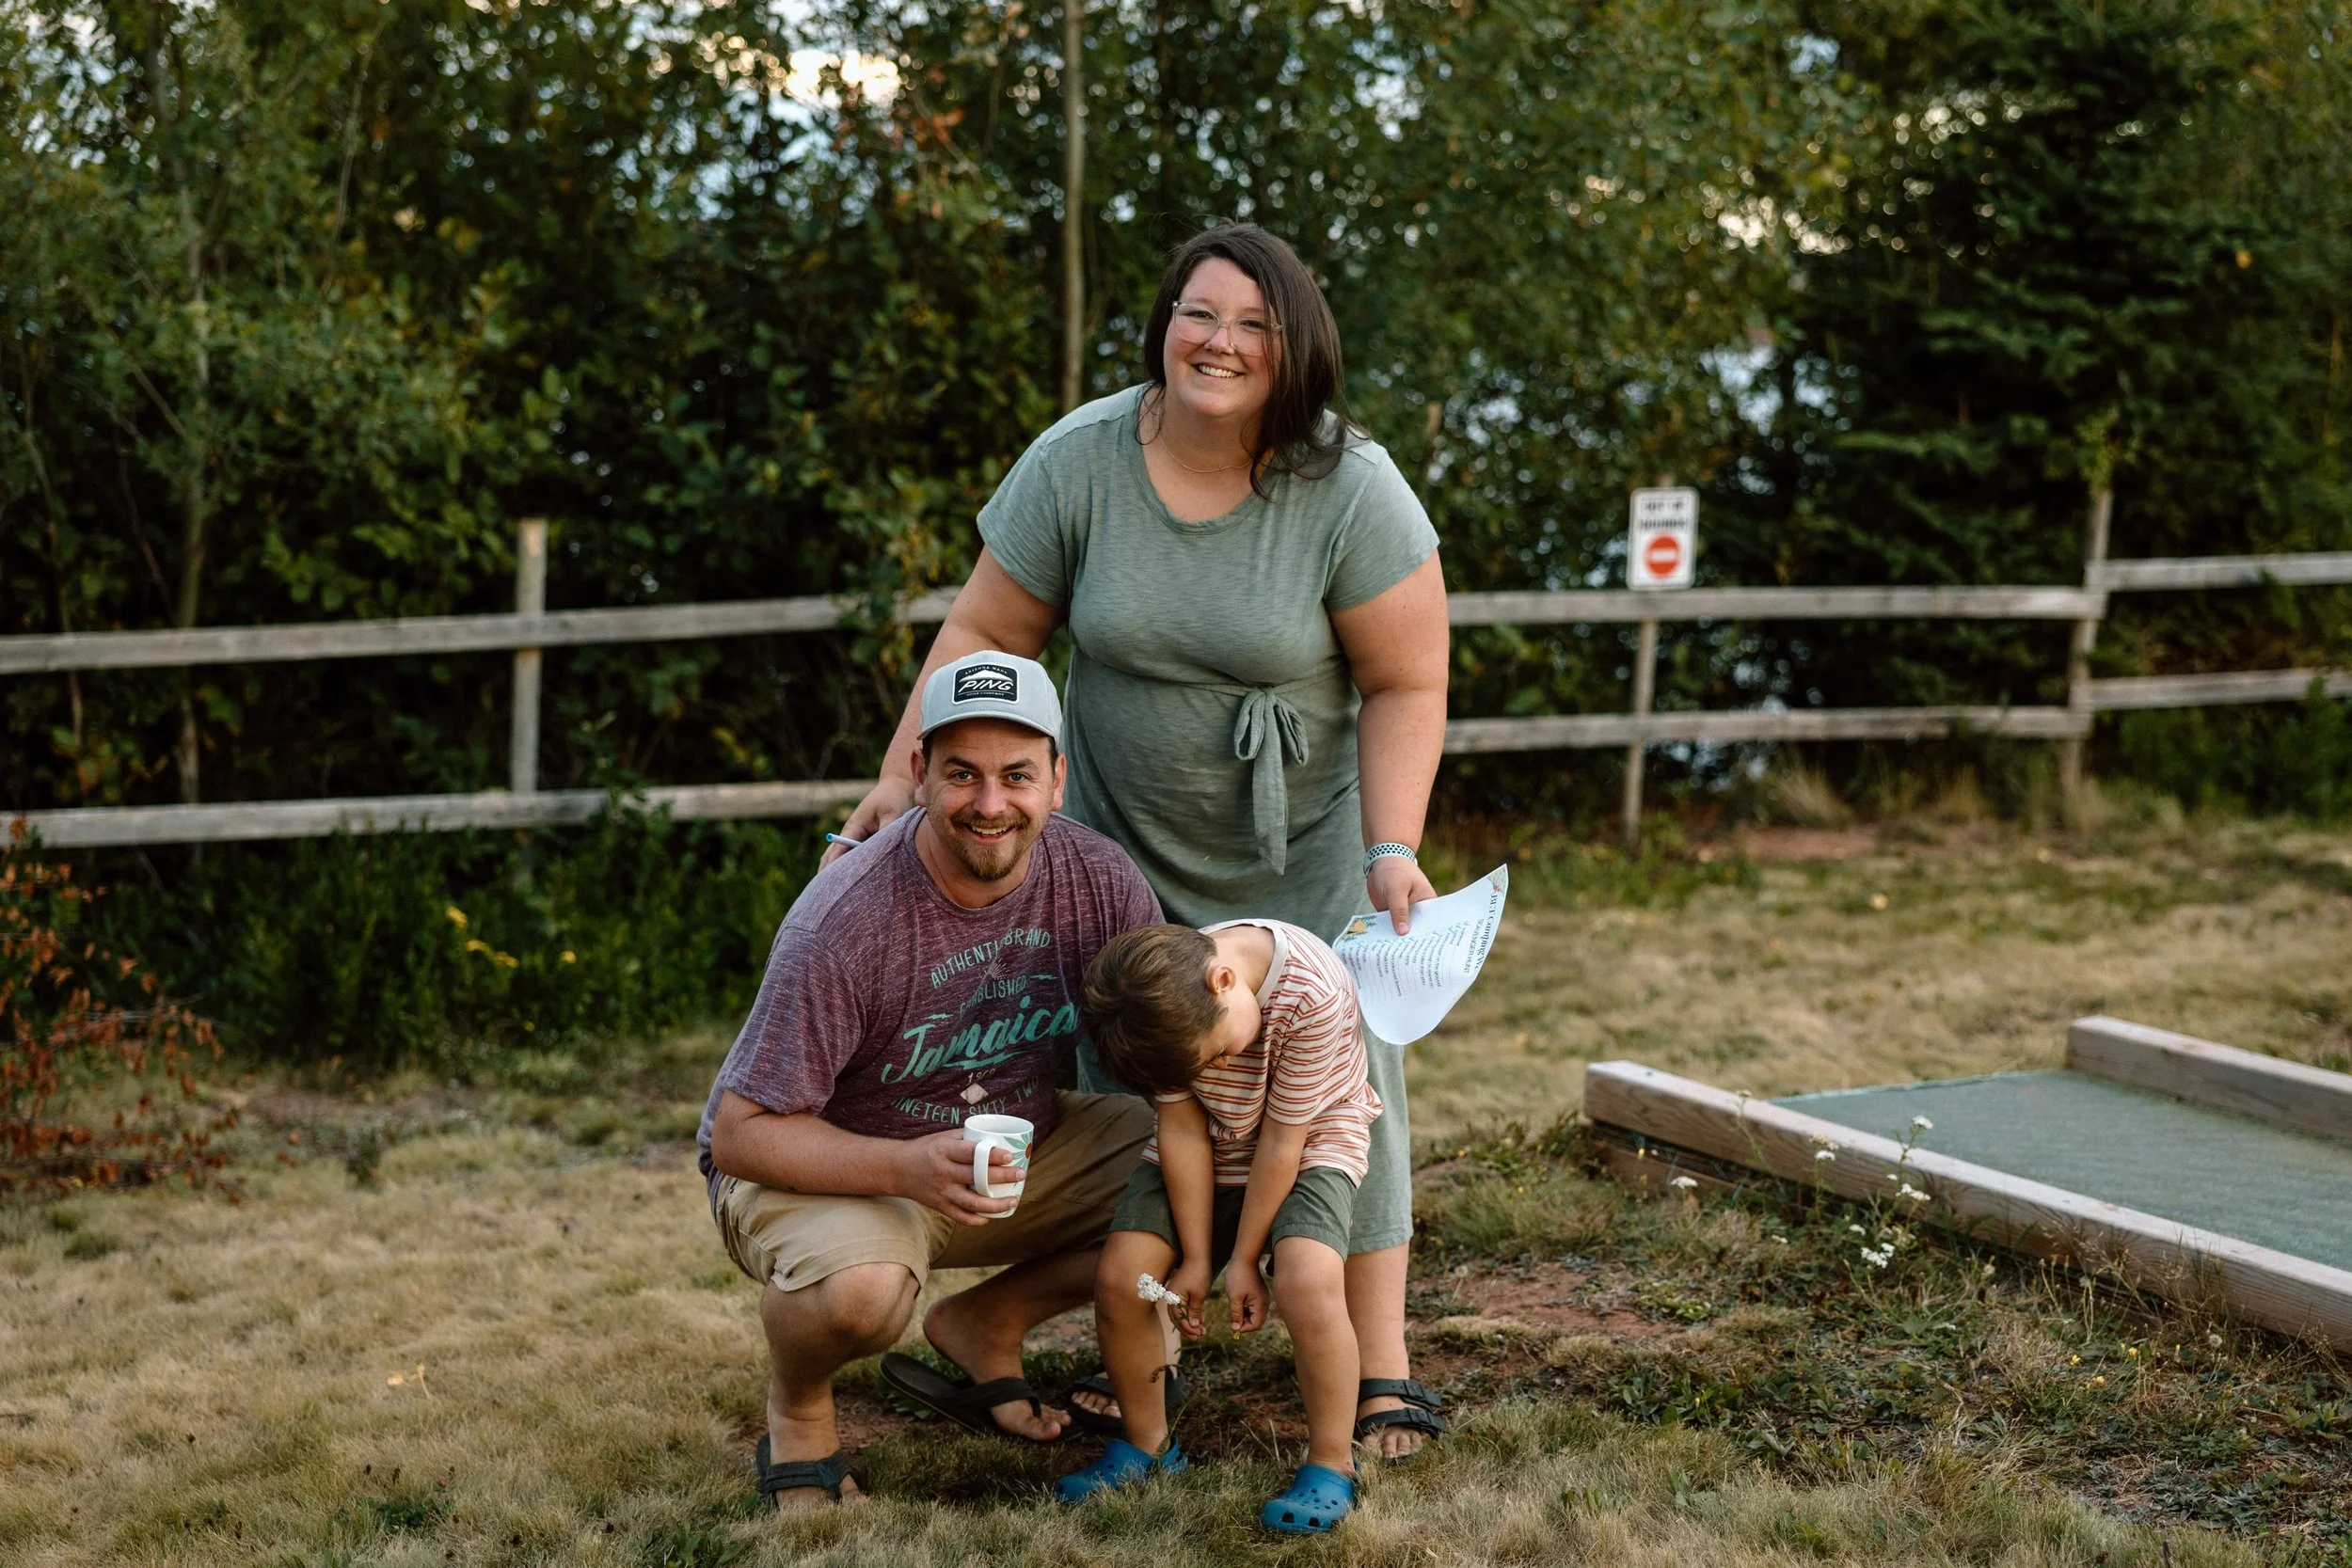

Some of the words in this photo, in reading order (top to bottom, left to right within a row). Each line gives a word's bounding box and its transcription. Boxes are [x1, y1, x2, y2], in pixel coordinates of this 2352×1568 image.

[958, 679, 1014, 693] PING
[964, 666, 990, 674] ARIZONA
[930, 940, 1001, 989] AUTHENTI
[1004, 927, 1051, 947] BRAND
[881, 995, 1079, 1085] Jamaica
[894, 1097, 960, 1125] INETEEN
[1014, 1075, 1040, 1103] TWO
